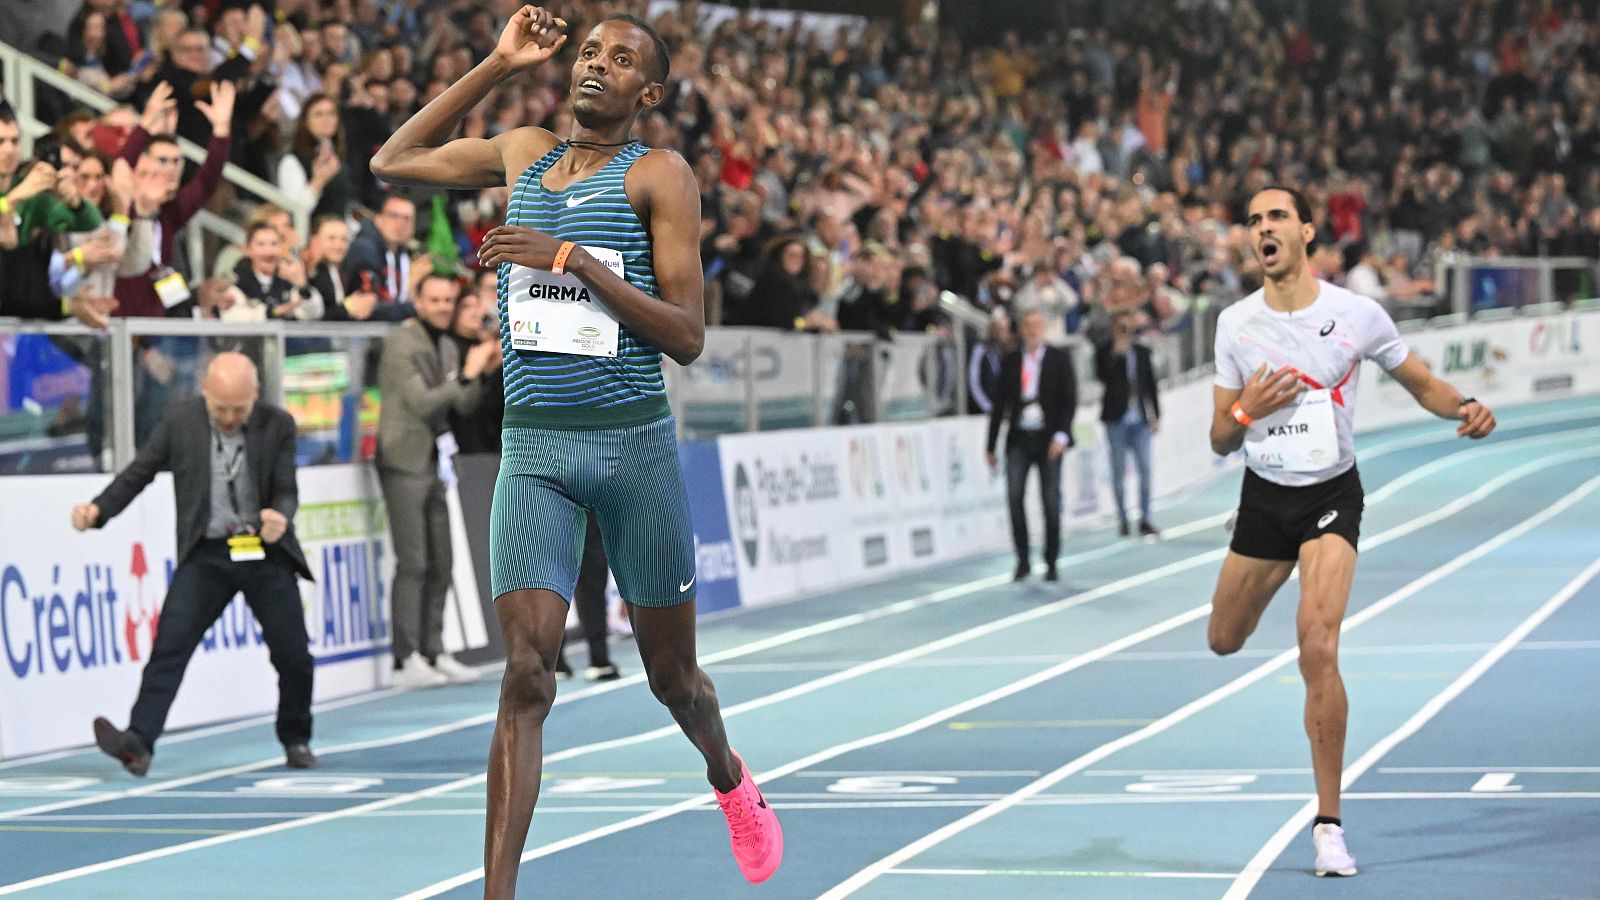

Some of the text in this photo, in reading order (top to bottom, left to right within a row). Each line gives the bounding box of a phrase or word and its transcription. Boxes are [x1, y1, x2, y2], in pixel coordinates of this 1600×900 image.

[529, 284, 591, 303] GIRMA
[1268, 424, 1309, 437] KATIR
[1, 563, 122, 679] Crédit
